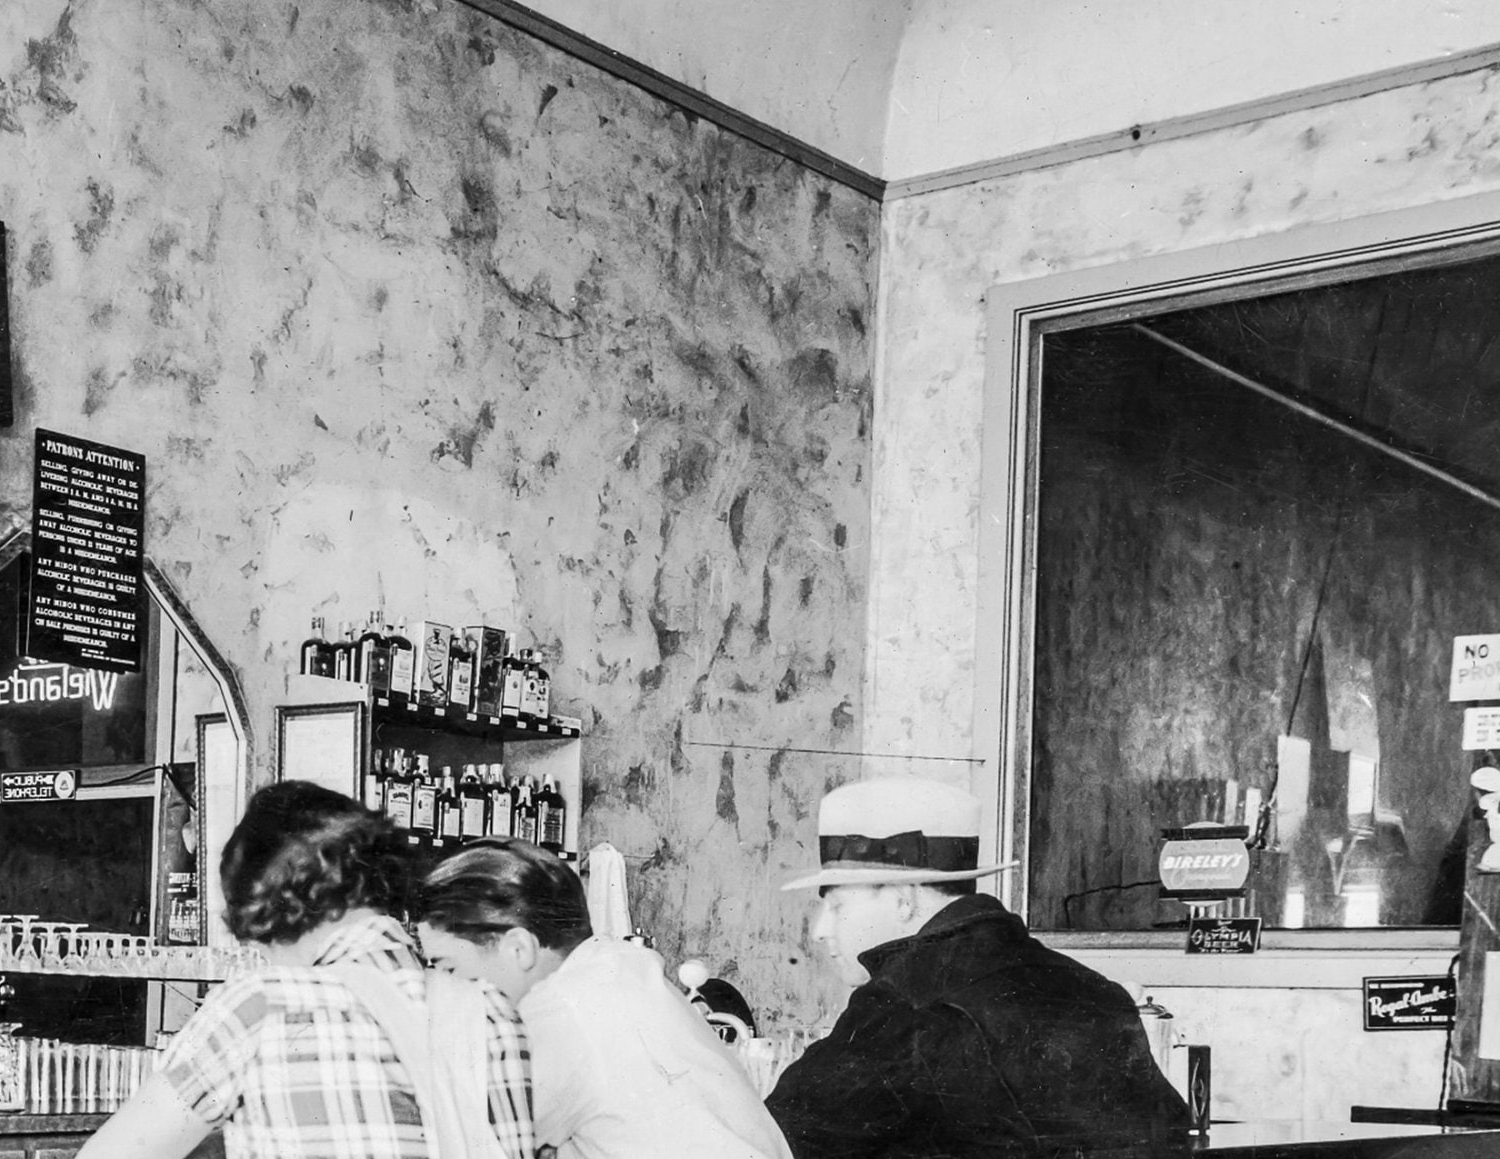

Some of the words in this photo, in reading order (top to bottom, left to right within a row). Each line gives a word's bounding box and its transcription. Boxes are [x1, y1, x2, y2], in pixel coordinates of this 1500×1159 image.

[46, 439, 83, 460] PATRONS
[85, 450, 135, 472] ATTENTION
[97, 473, 115, 484] AWAY
[1464, 644, 1489, 660] NO
[1162, 852, 1244, 870] BIRELEY'S
[1190, 928, 1254, 946] OLYMPIA
